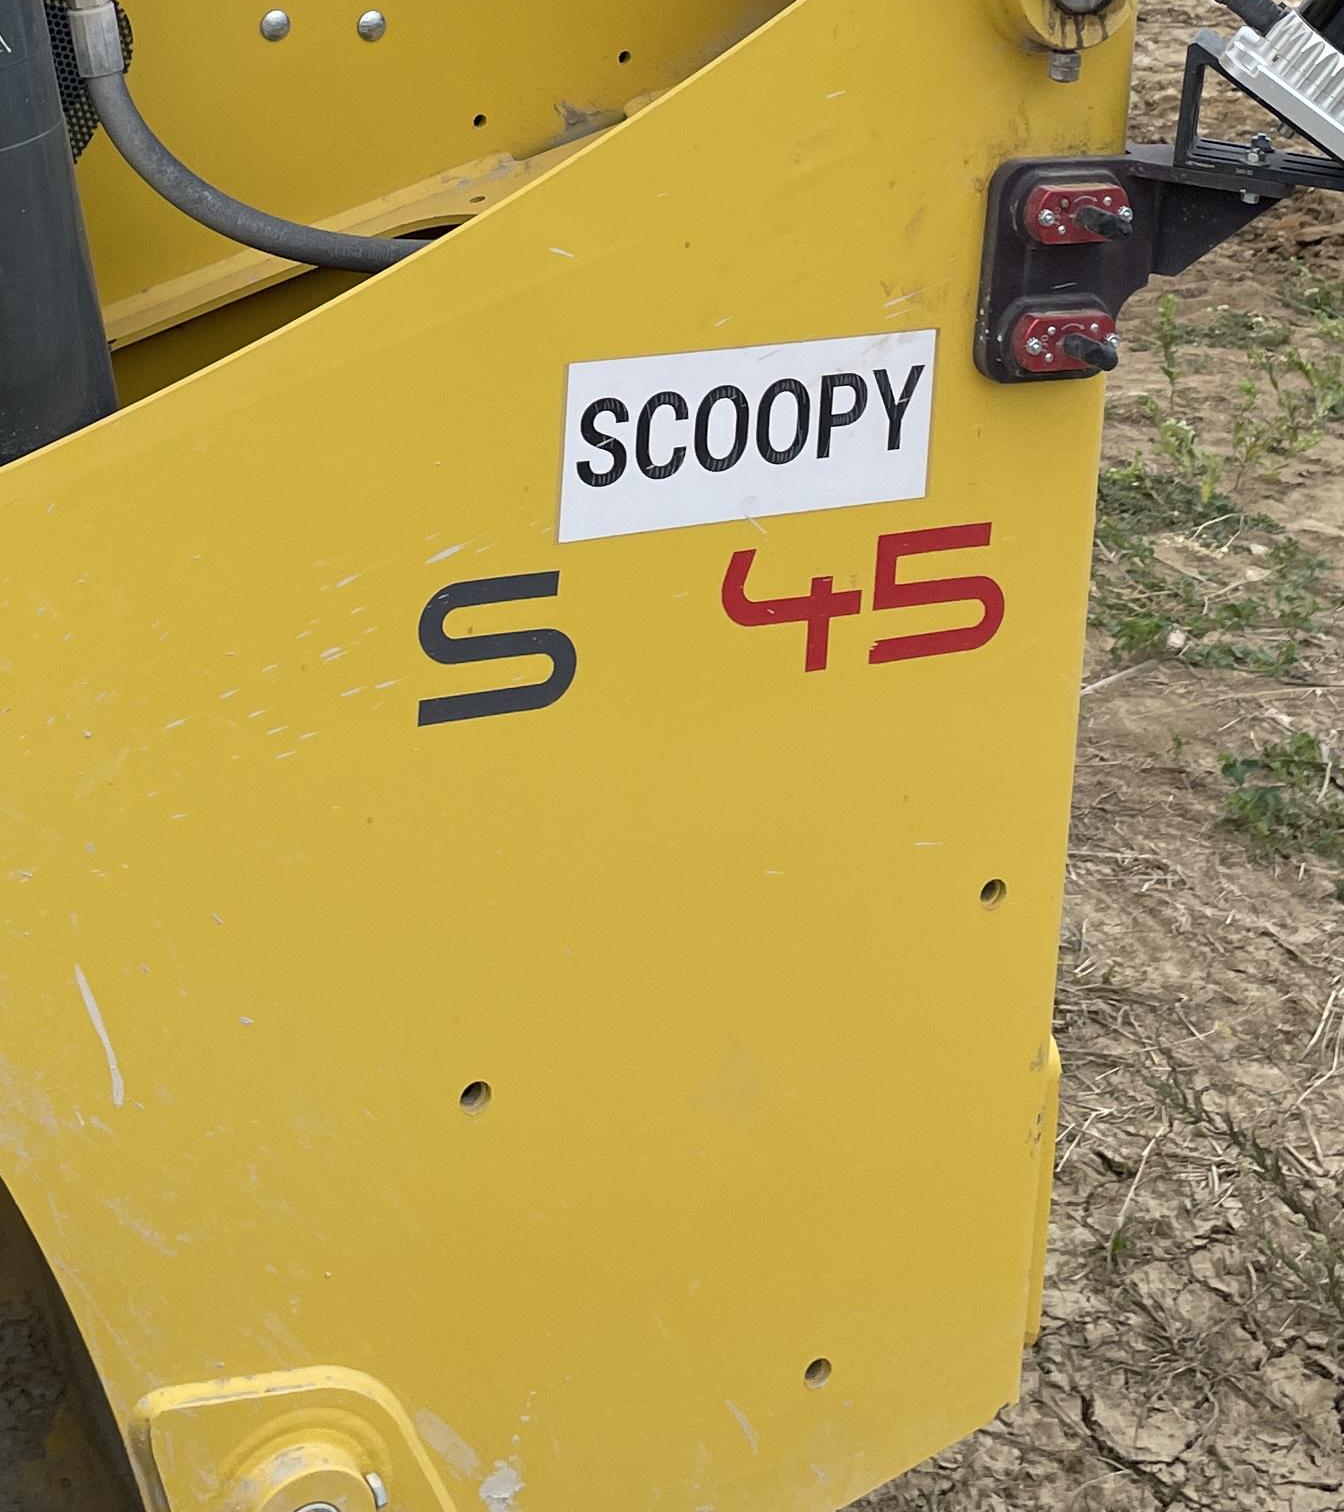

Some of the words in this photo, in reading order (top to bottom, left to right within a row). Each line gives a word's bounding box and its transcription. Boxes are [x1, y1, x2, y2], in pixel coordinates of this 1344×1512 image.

[575, 364, 926, 489] SCOOPY
[417, 570, 577, 728] S
[721, 522, 1005, 673] 45
